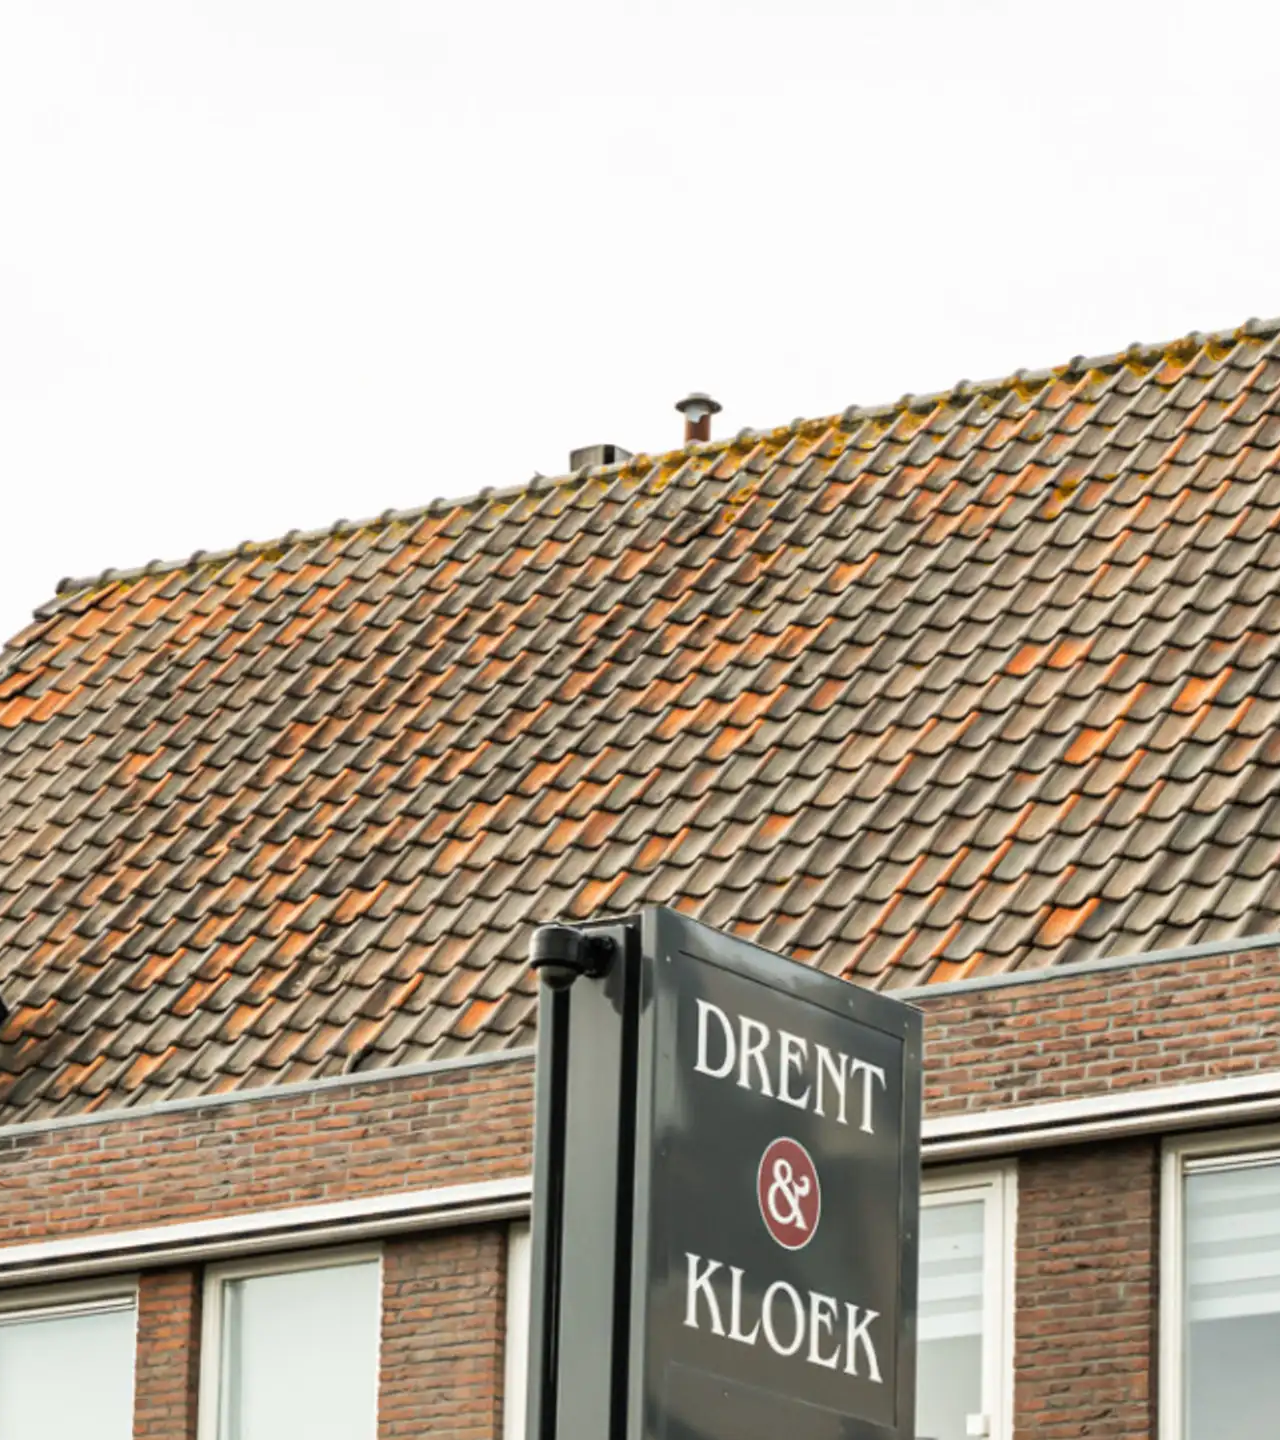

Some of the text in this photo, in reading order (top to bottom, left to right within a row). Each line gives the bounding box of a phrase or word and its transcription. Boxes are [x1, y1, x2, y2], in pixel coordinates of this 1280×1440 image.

[693, 998, 886, 1134] DRENT
[767, 1158, 811, 1231] &
[683, 1252, 883, 1384] KLOEK
